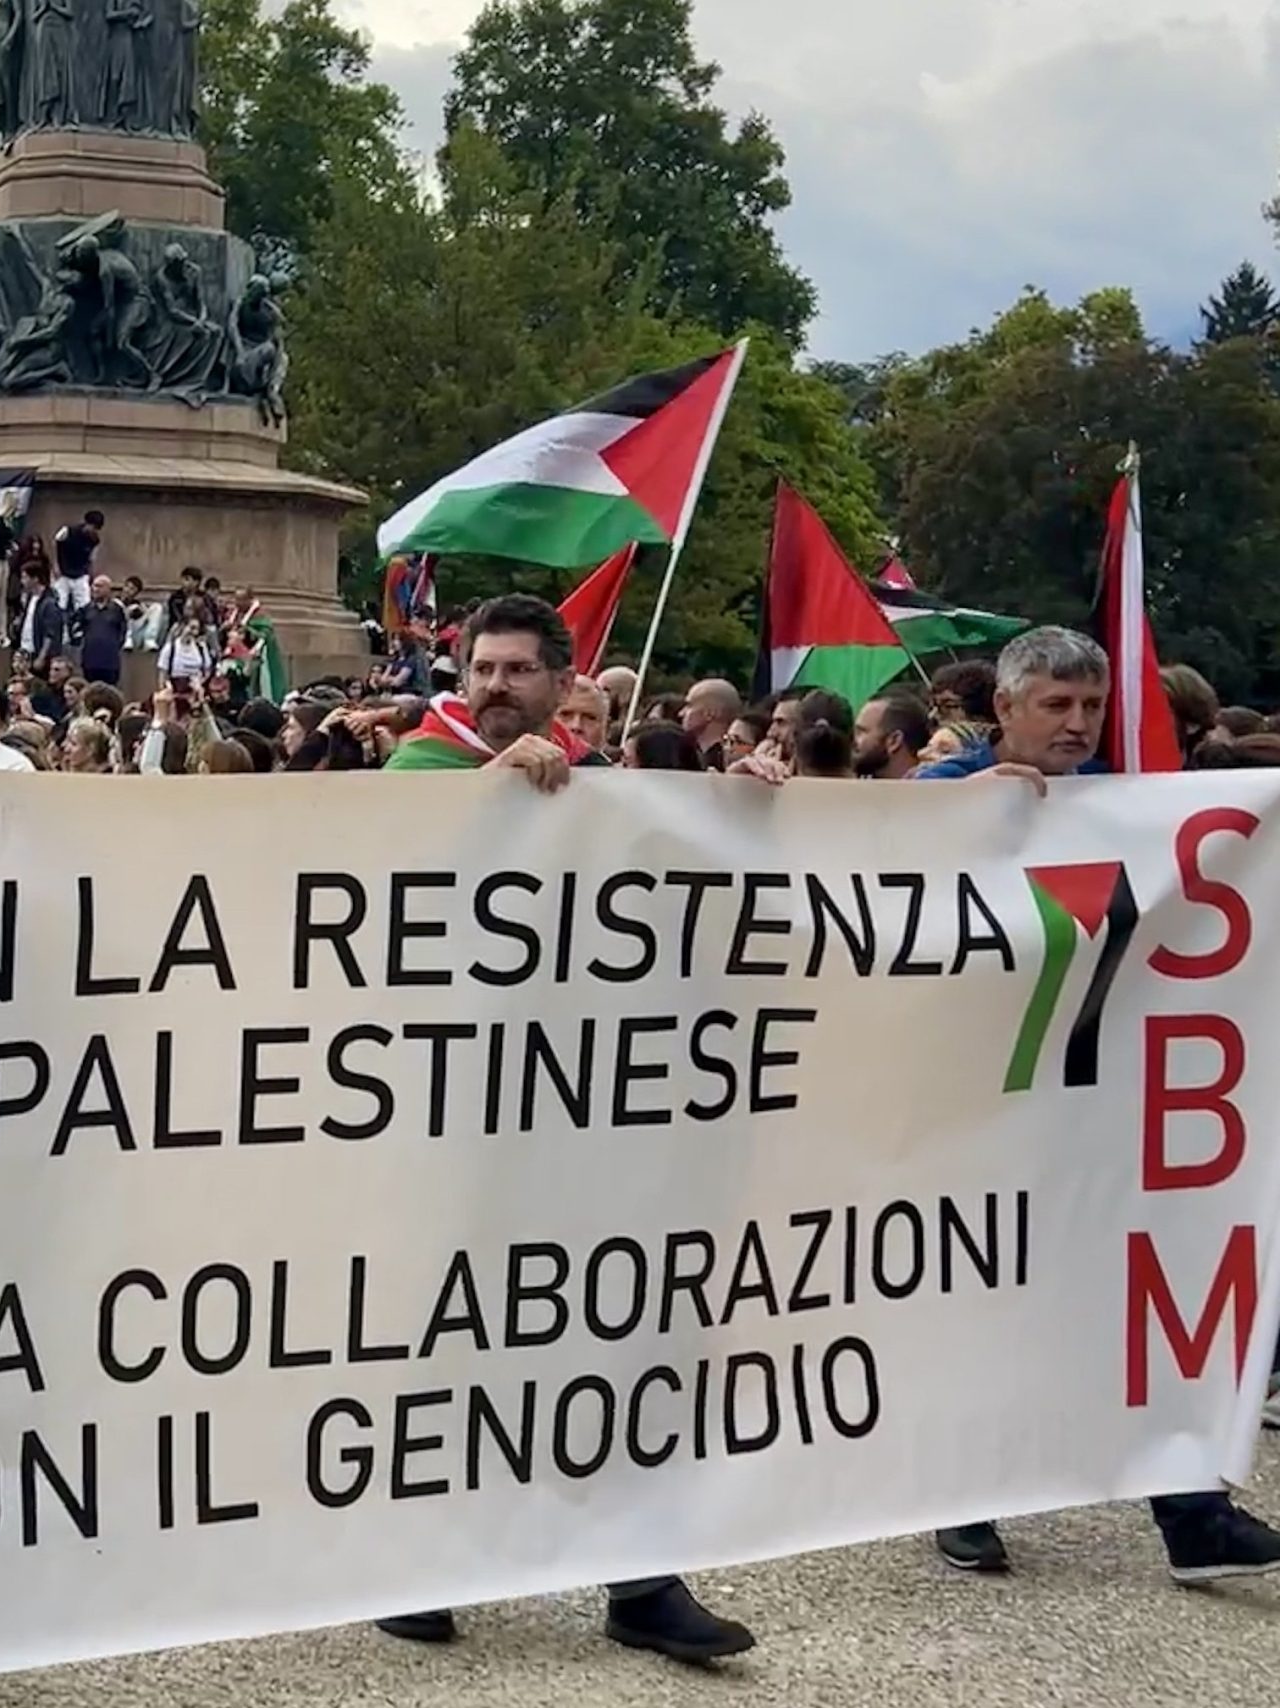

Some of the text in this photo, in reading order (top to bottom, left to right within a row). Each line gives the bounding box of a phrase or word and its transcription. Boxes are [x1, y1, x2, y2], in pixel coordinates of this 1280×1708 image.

[74, 874, 237, 997] LA
[293, 870, 1016, 989] RESISTENZA
[1126, 808, 1261, 1408] SBM
[98, 1190, 1029, 1383] COLLABORAZIONI
[158, 1411, 259, 1530] IL
[306, 1335, 880, 1509] GENOCIDIO
